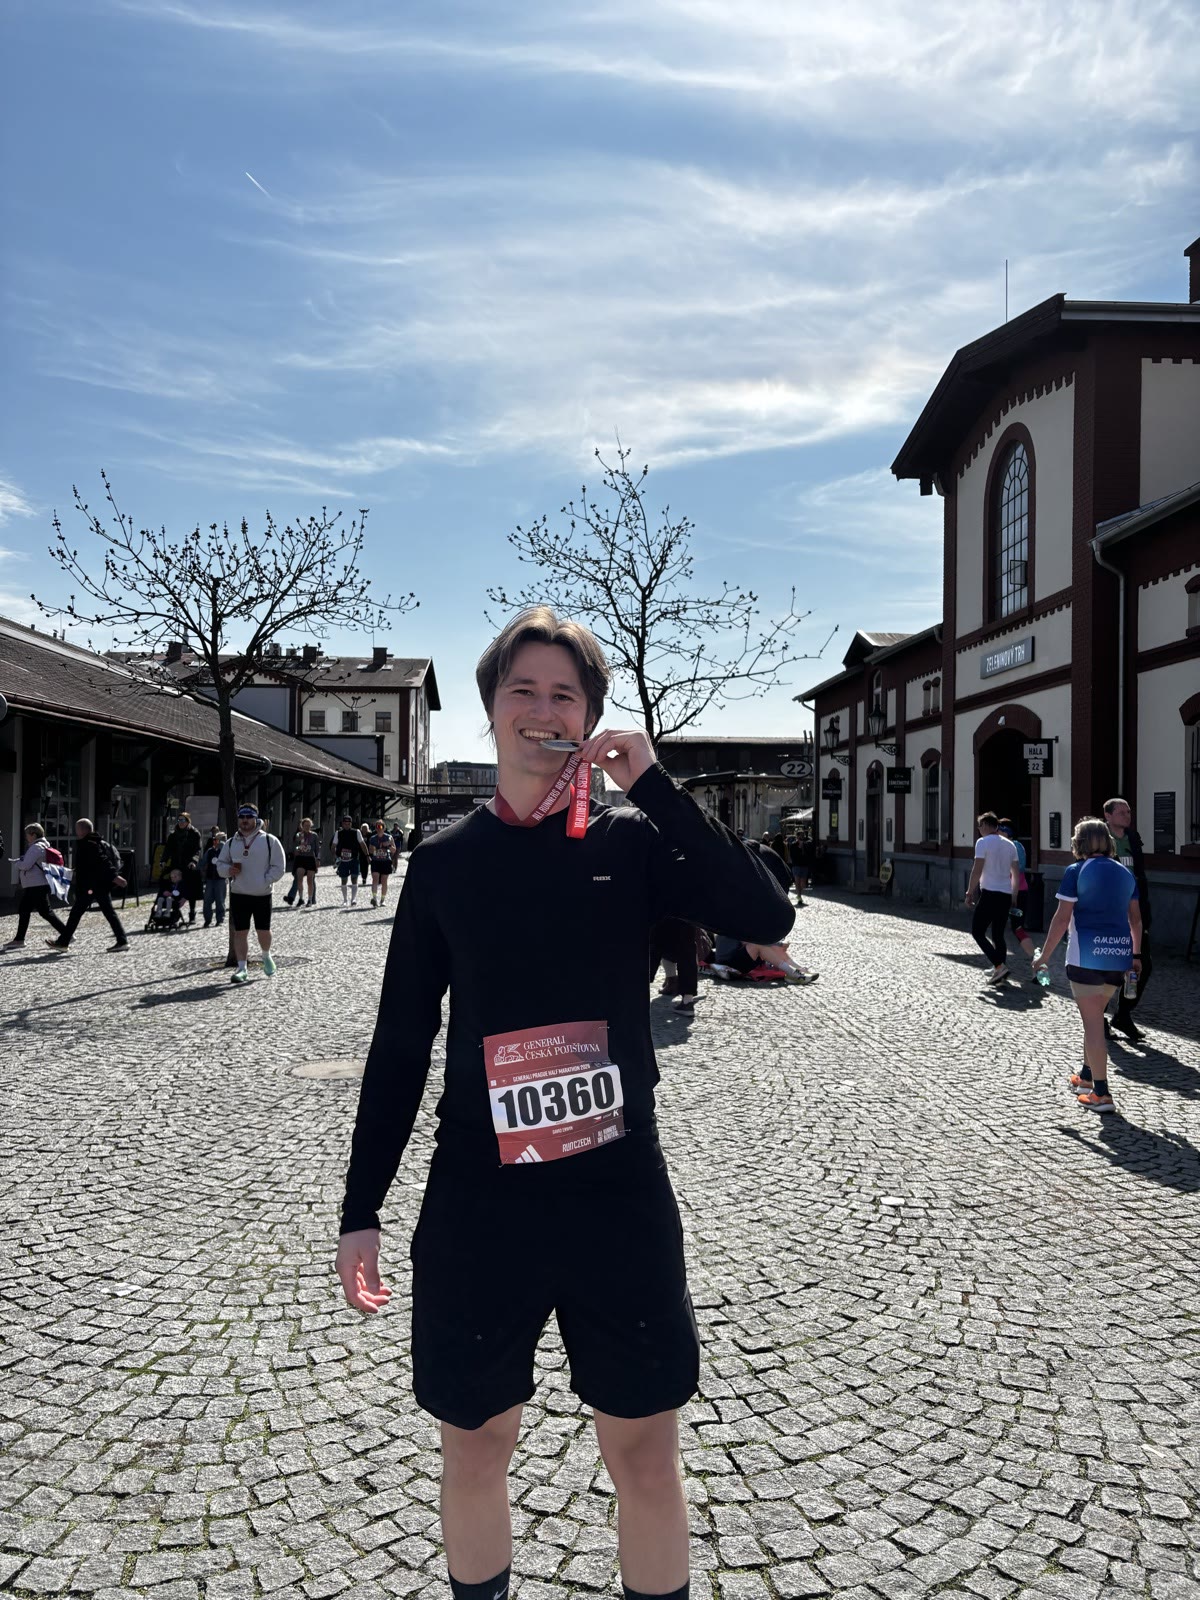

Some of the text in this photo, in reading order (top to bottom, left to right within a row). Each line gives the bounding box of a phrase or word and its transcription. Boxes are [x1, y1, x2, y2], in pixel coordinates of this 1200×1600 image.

[1014, 644, 1025, 663] TRH
[787, 763, 805, 775] 22
[532, 754, 581, 822] ALL RUNNERS ARE BEAUTIFU
[576, 789, 587, 801] ARE
[1092, 947, 1132, 956] ARROWS
[524, 1035, 566, 1050] GENERALI
[525, 1042, 600, 1060] ČESKÁ POJIŠŤOVNA
[512, 1074, 532, 1082] GENERALI
[532, 1070, 548, 1079] PRAGUE
[558, 1066, 580, 1074] MARATHON
[498, 1071, 615, 1128] 10360
[612, 1108, 620, 1117] K
